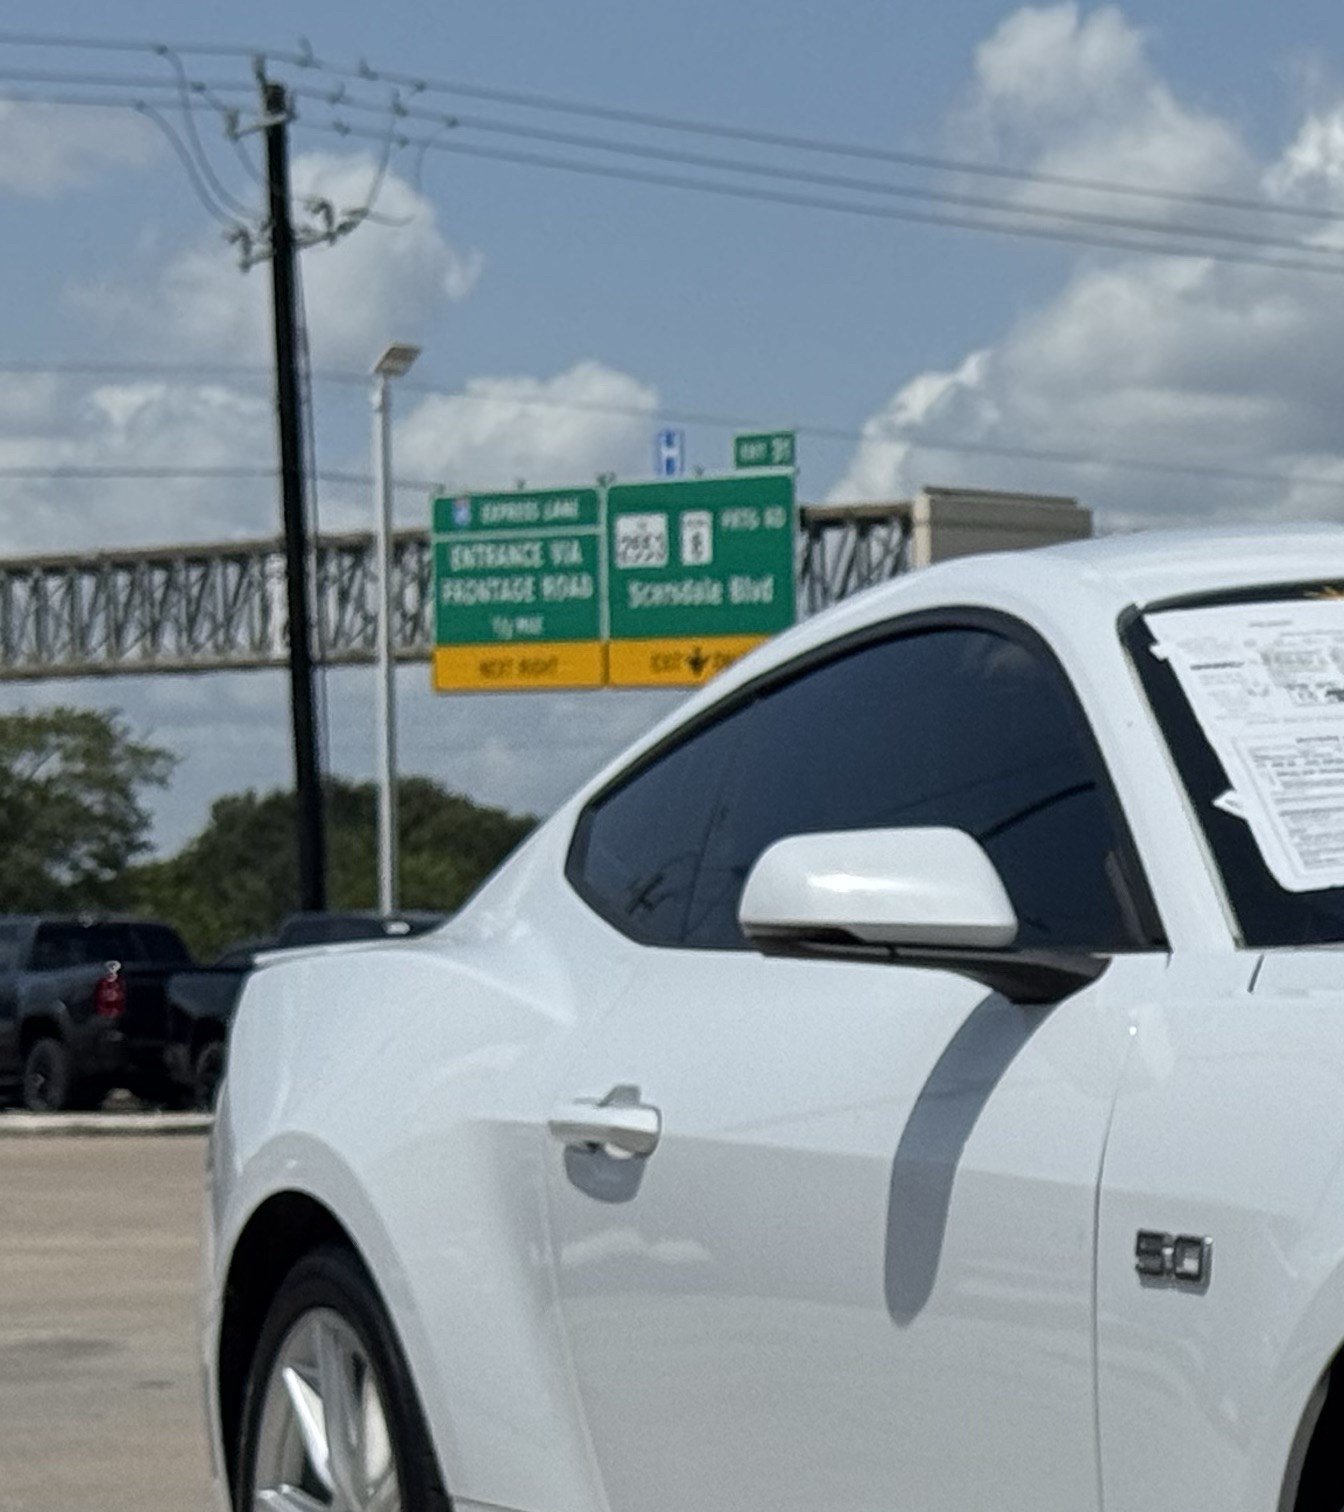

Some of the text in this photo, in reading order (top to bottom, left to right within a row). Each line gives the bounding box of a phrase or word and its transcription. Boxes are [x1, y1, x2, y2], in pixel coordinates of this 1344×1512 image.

[450, 539, 584, 572] ENTRANCE VIA
[440, 572, 595, 606] FRONTAGE ROAD
[628, 573, 775, 610] Scarsdale Blvd
[1135, 1229, 1213, 1282] 5.0
